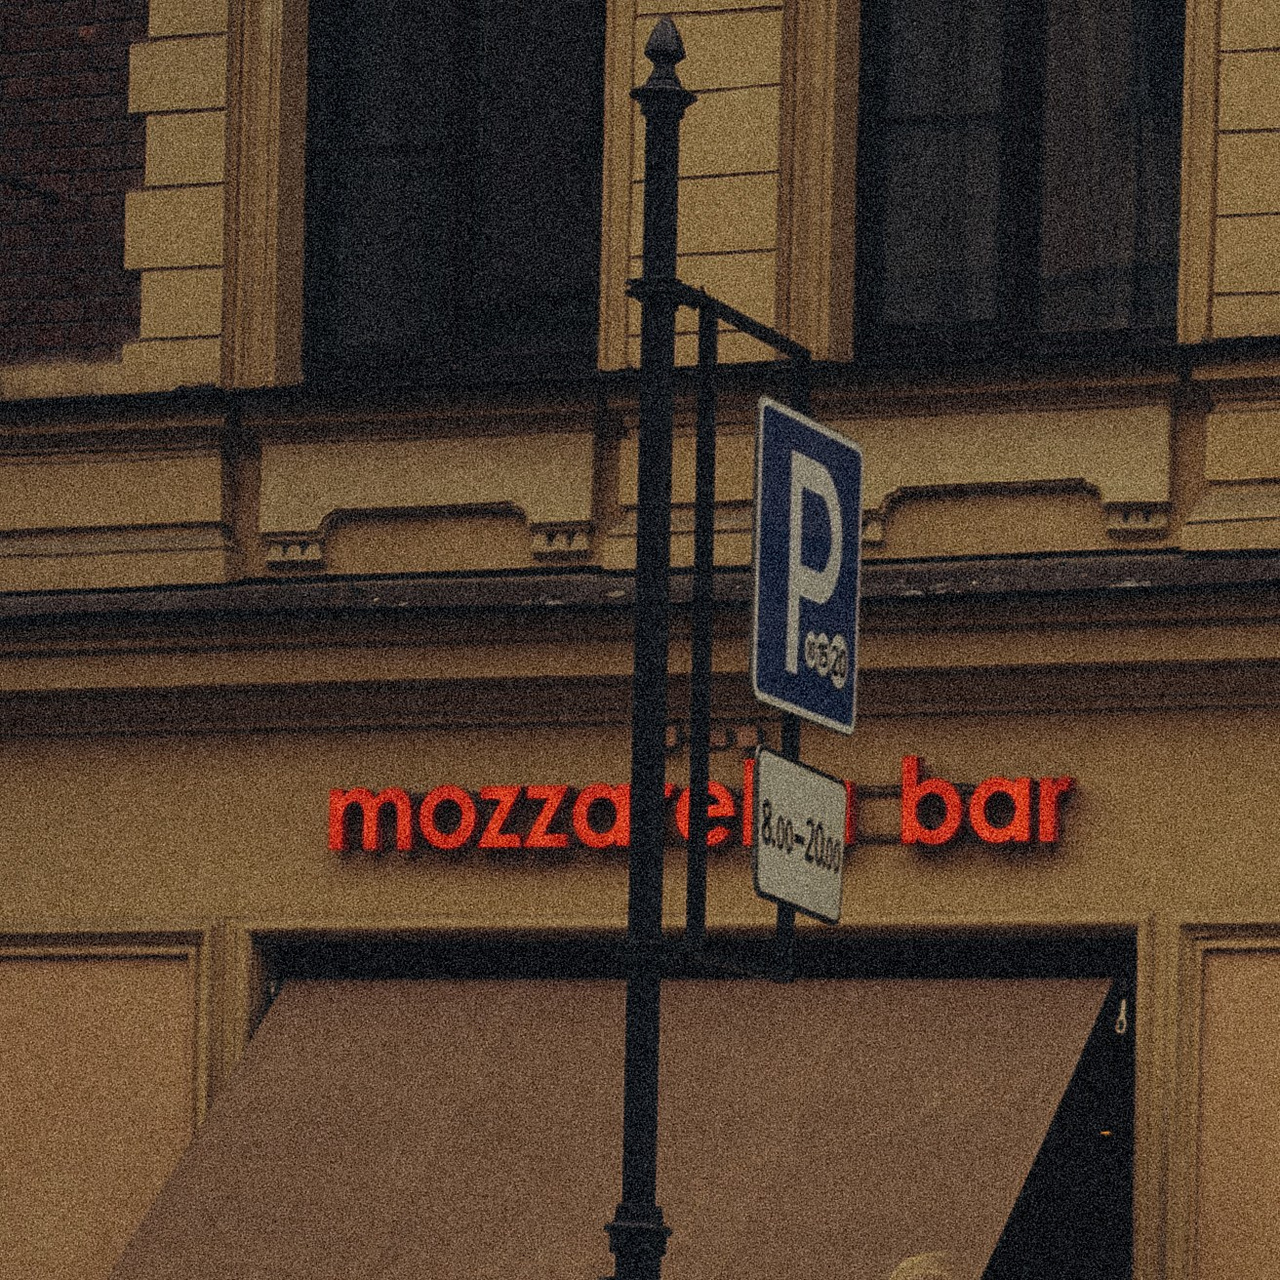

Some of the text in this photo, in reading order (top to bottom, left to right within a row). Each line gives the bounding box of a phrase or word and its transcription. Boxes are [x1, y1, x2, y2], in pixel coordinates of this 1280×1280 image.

[785, 450, 843, 675] P
[831, 645, 847, 678] 20
[900, 754, 1074, 845] bar
